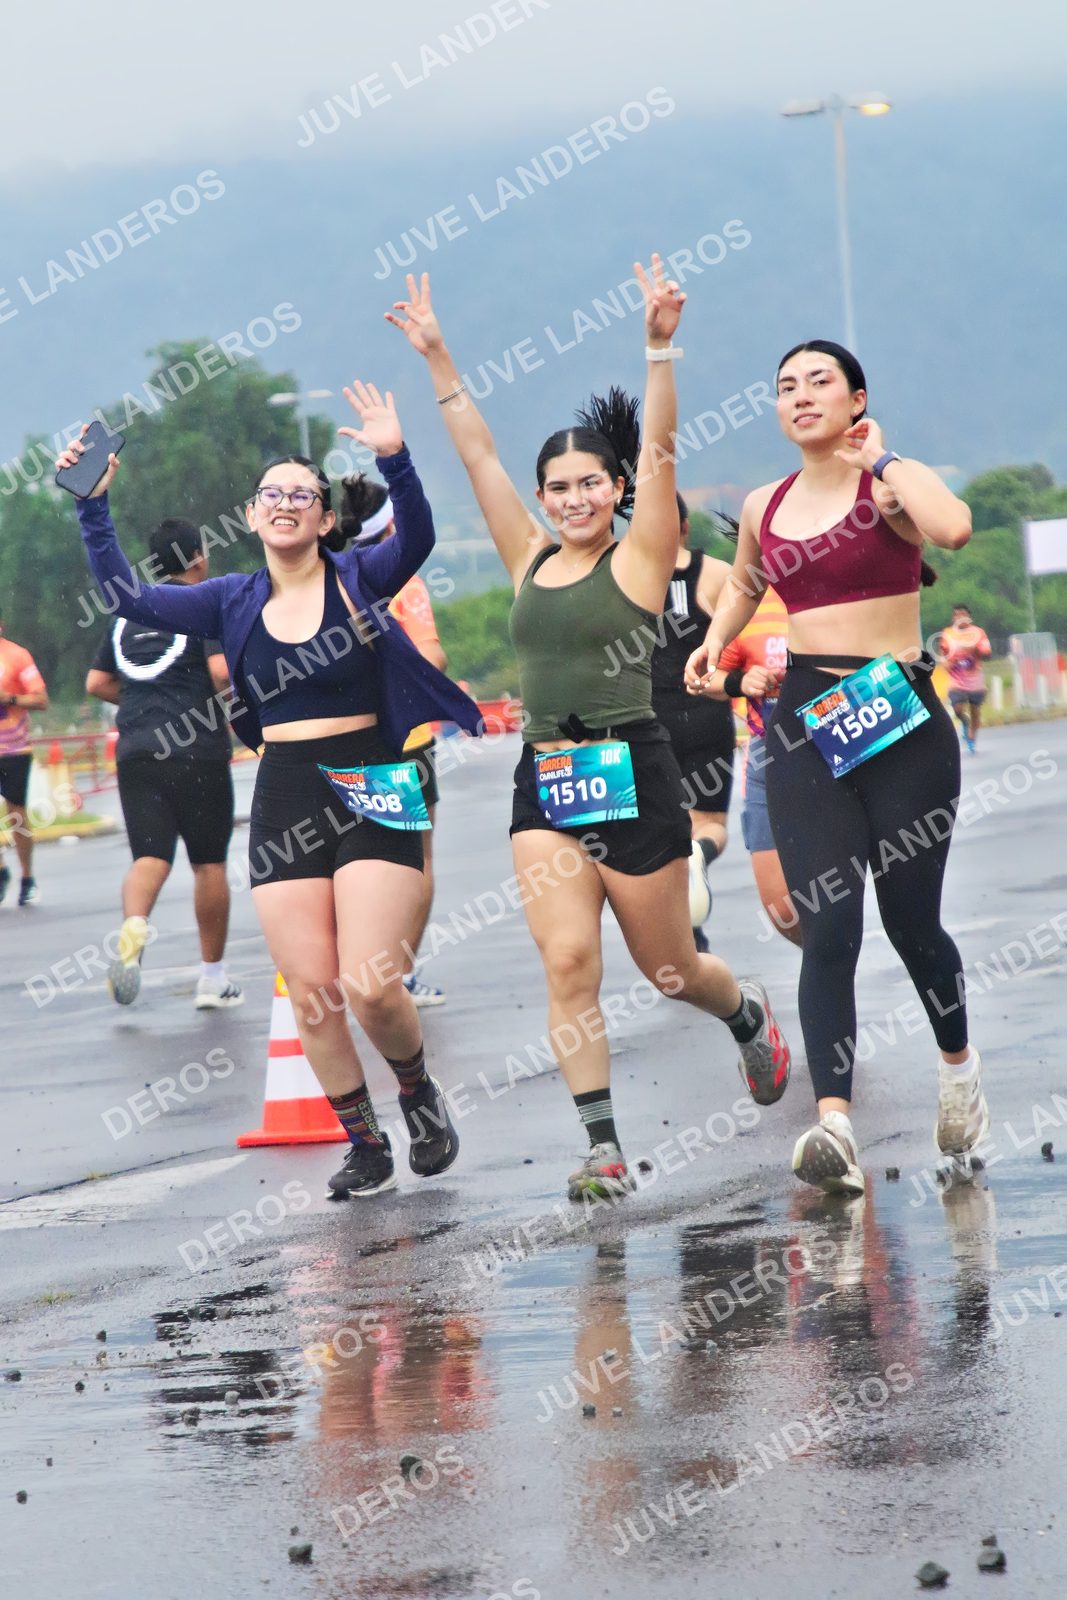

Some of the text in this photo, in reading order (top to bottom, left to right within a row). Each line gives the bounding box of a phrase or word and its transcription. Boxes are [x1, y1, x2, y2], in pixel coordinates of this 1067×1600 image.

[868, 661, 891, 685] 10K
[806, 689, 847, 717] ARRERA
[831, 697, 893, 745] 1509
[539, 755, 572, 773] CARRERA
[600, 748, 621, 765] 10K
[391, 769, 410, 784] 10K
[549, 776, 607, 806] 1510
